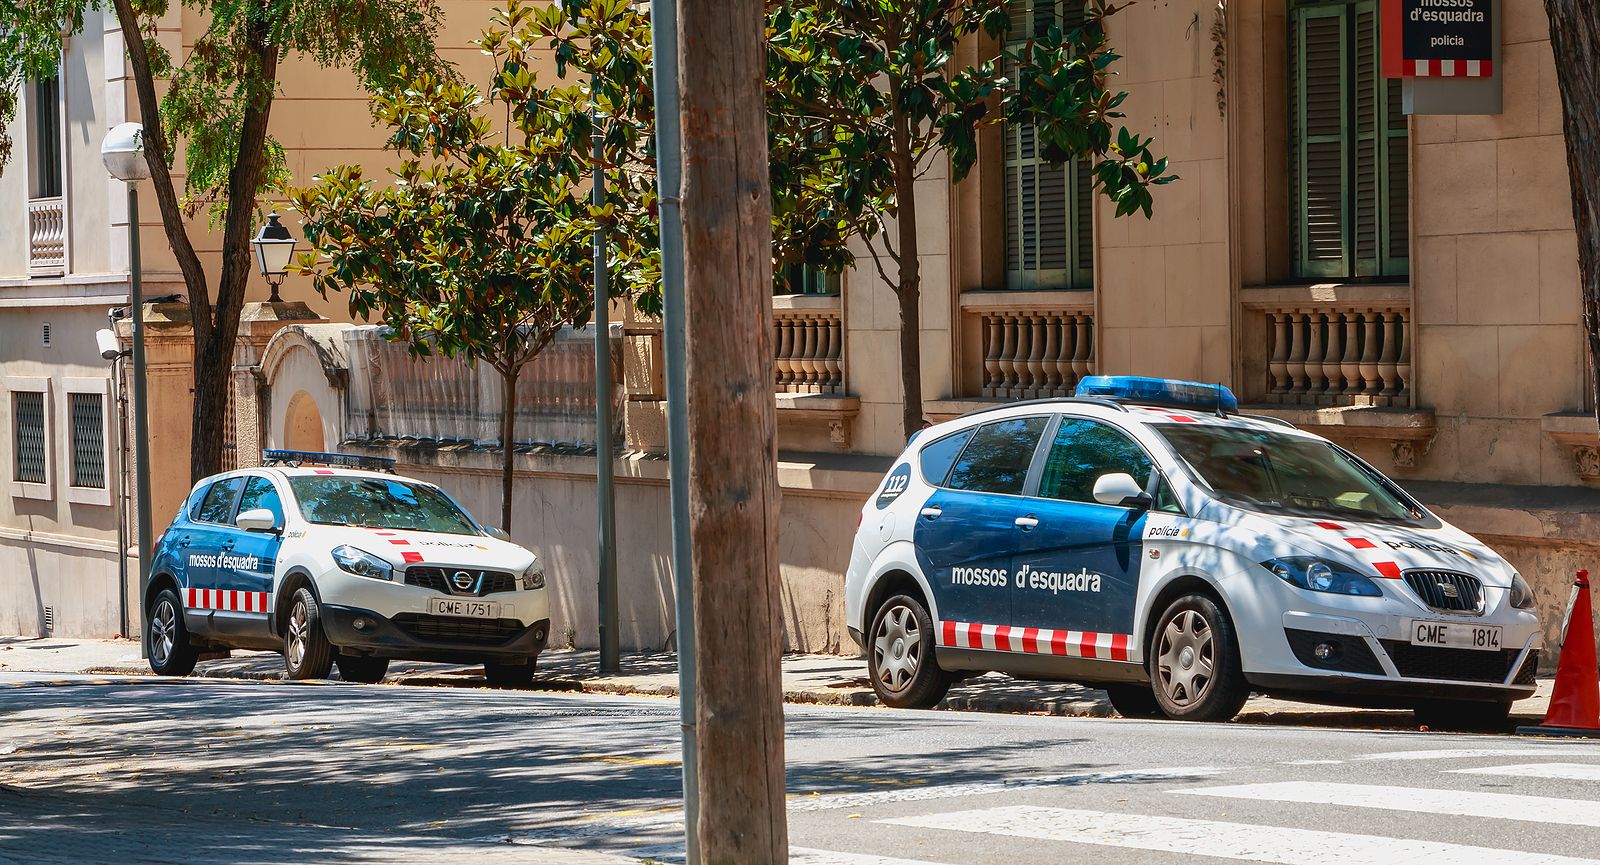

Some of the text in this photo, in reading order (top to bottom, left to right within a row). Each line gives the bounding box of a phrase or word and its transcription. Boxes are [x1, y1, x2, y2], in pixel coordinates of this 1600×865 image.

[1410, 8, 1484, 24] d'esquadra
[1431, 35, 1464, 48] policia
[885, 475, 908, 493] 112
[189, 551, 258, 572] mossos d'esquadra
[952, 564, 1101, 595] mossos d'esquadra
[439, 601, 491, 616] CME 1751
[1417, 624, 1499, 648] CME 1814
